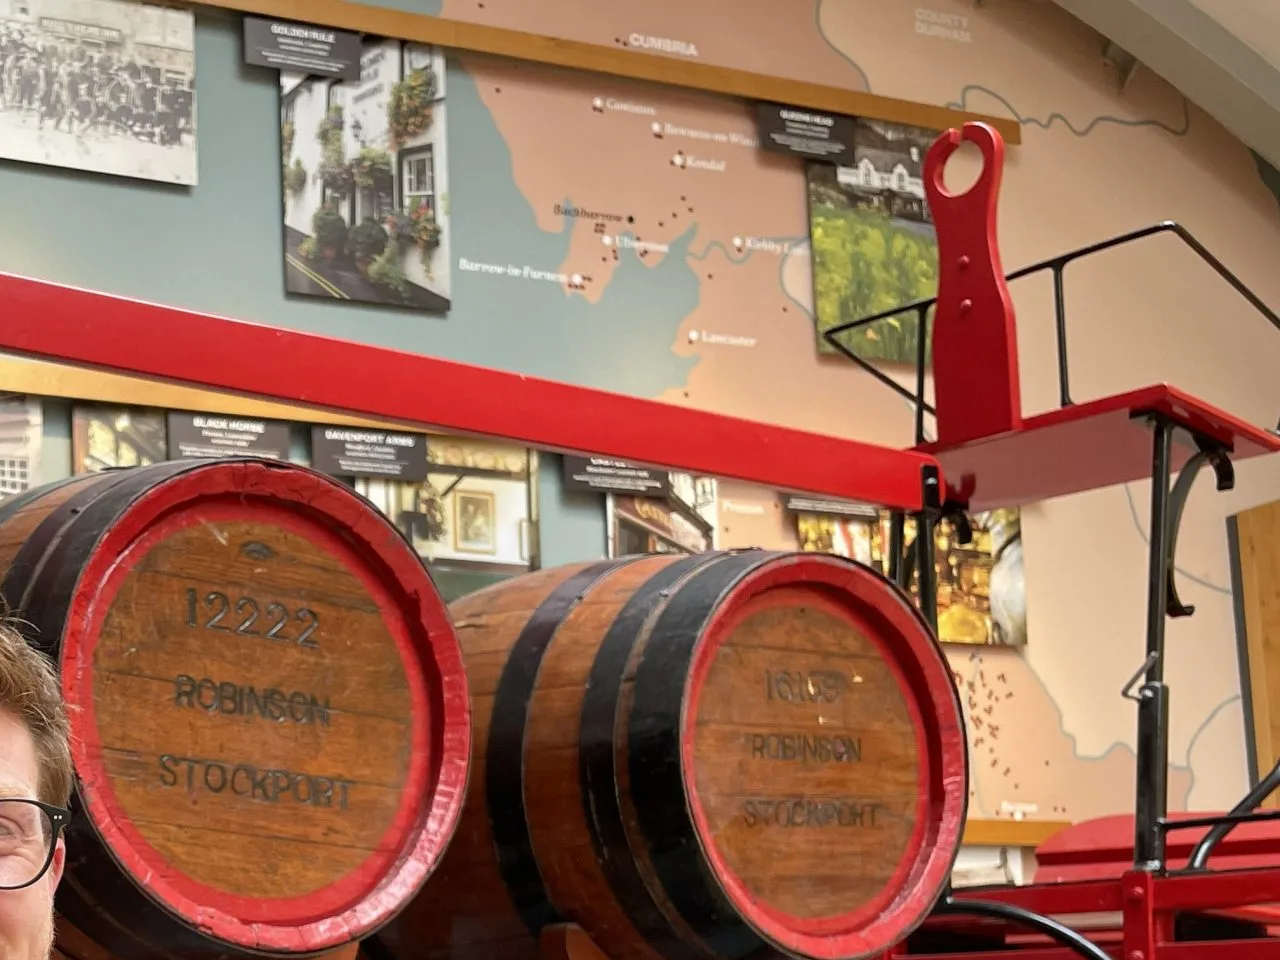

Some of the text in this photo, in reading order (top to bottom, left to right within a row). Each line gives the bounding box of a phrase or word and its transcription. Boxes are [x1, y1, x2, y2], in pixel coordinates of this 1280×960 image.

[629, 32, 698, 57] CUMBRIA
[184, 587, 320, 649] 12222
[174, 673, 332, 727] ROBINSON
[749, 732, 862, 763] ROBINSON
[158, 753, 356, 811] STOCKPORT
[742, 799, 883, 829] STOCKPORT
